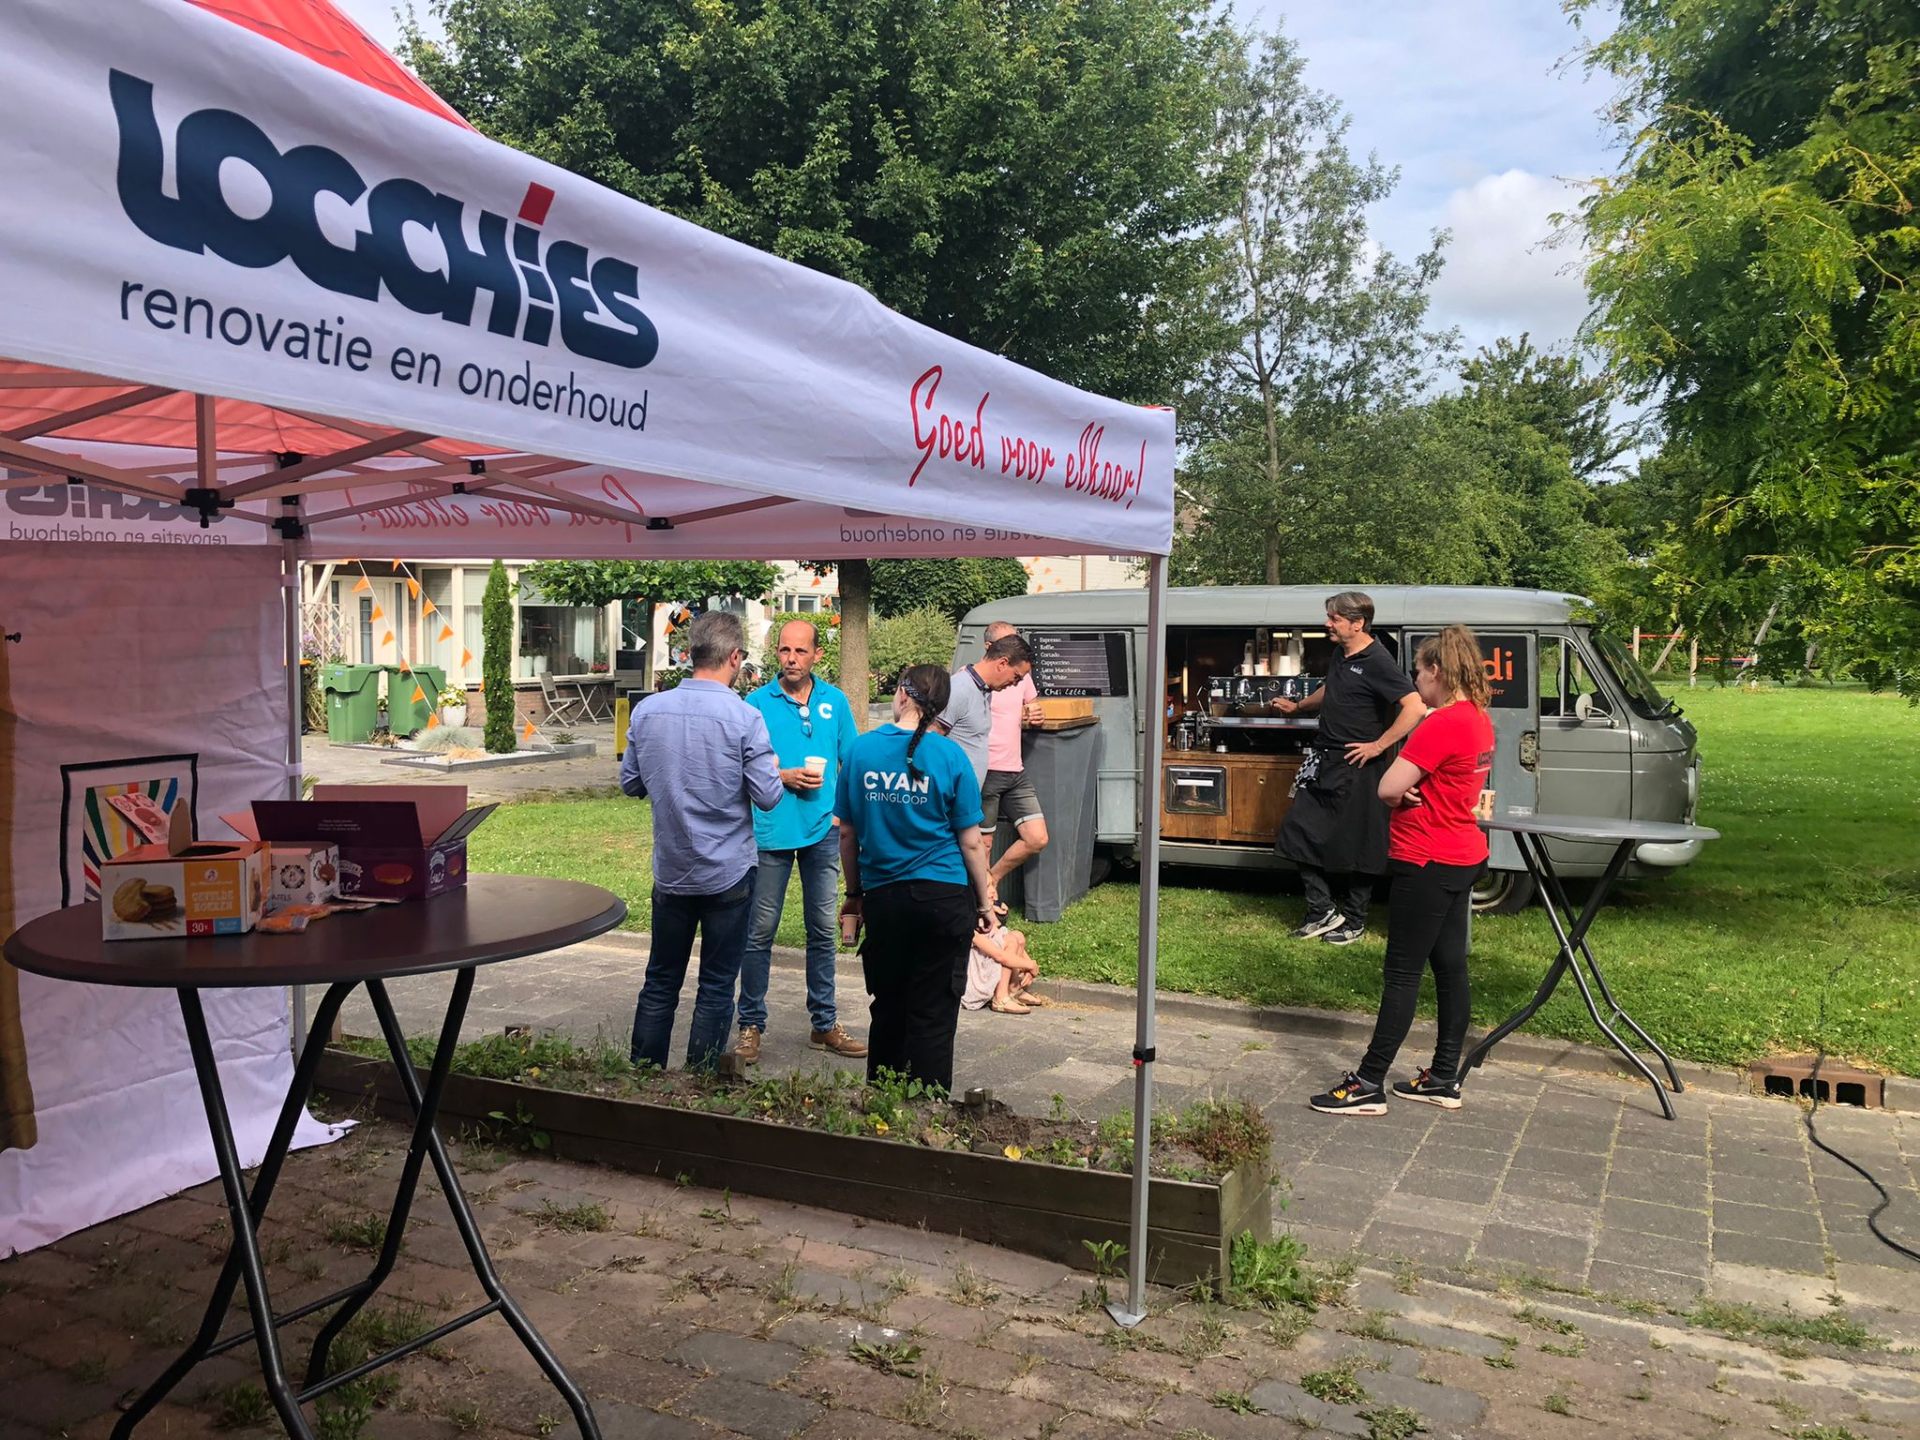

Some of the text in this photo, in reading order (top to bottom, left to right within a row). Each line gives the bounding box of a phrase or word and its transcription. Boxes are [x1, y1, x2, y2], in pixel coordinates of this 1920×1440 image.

[120, 279, 649, 432] renovatie en onderhoud
[909, 365, 1147, 511] Goed voor elkaar!
[818, 703, 833, 719] C
[863, 771, 930, 794] CYAN
